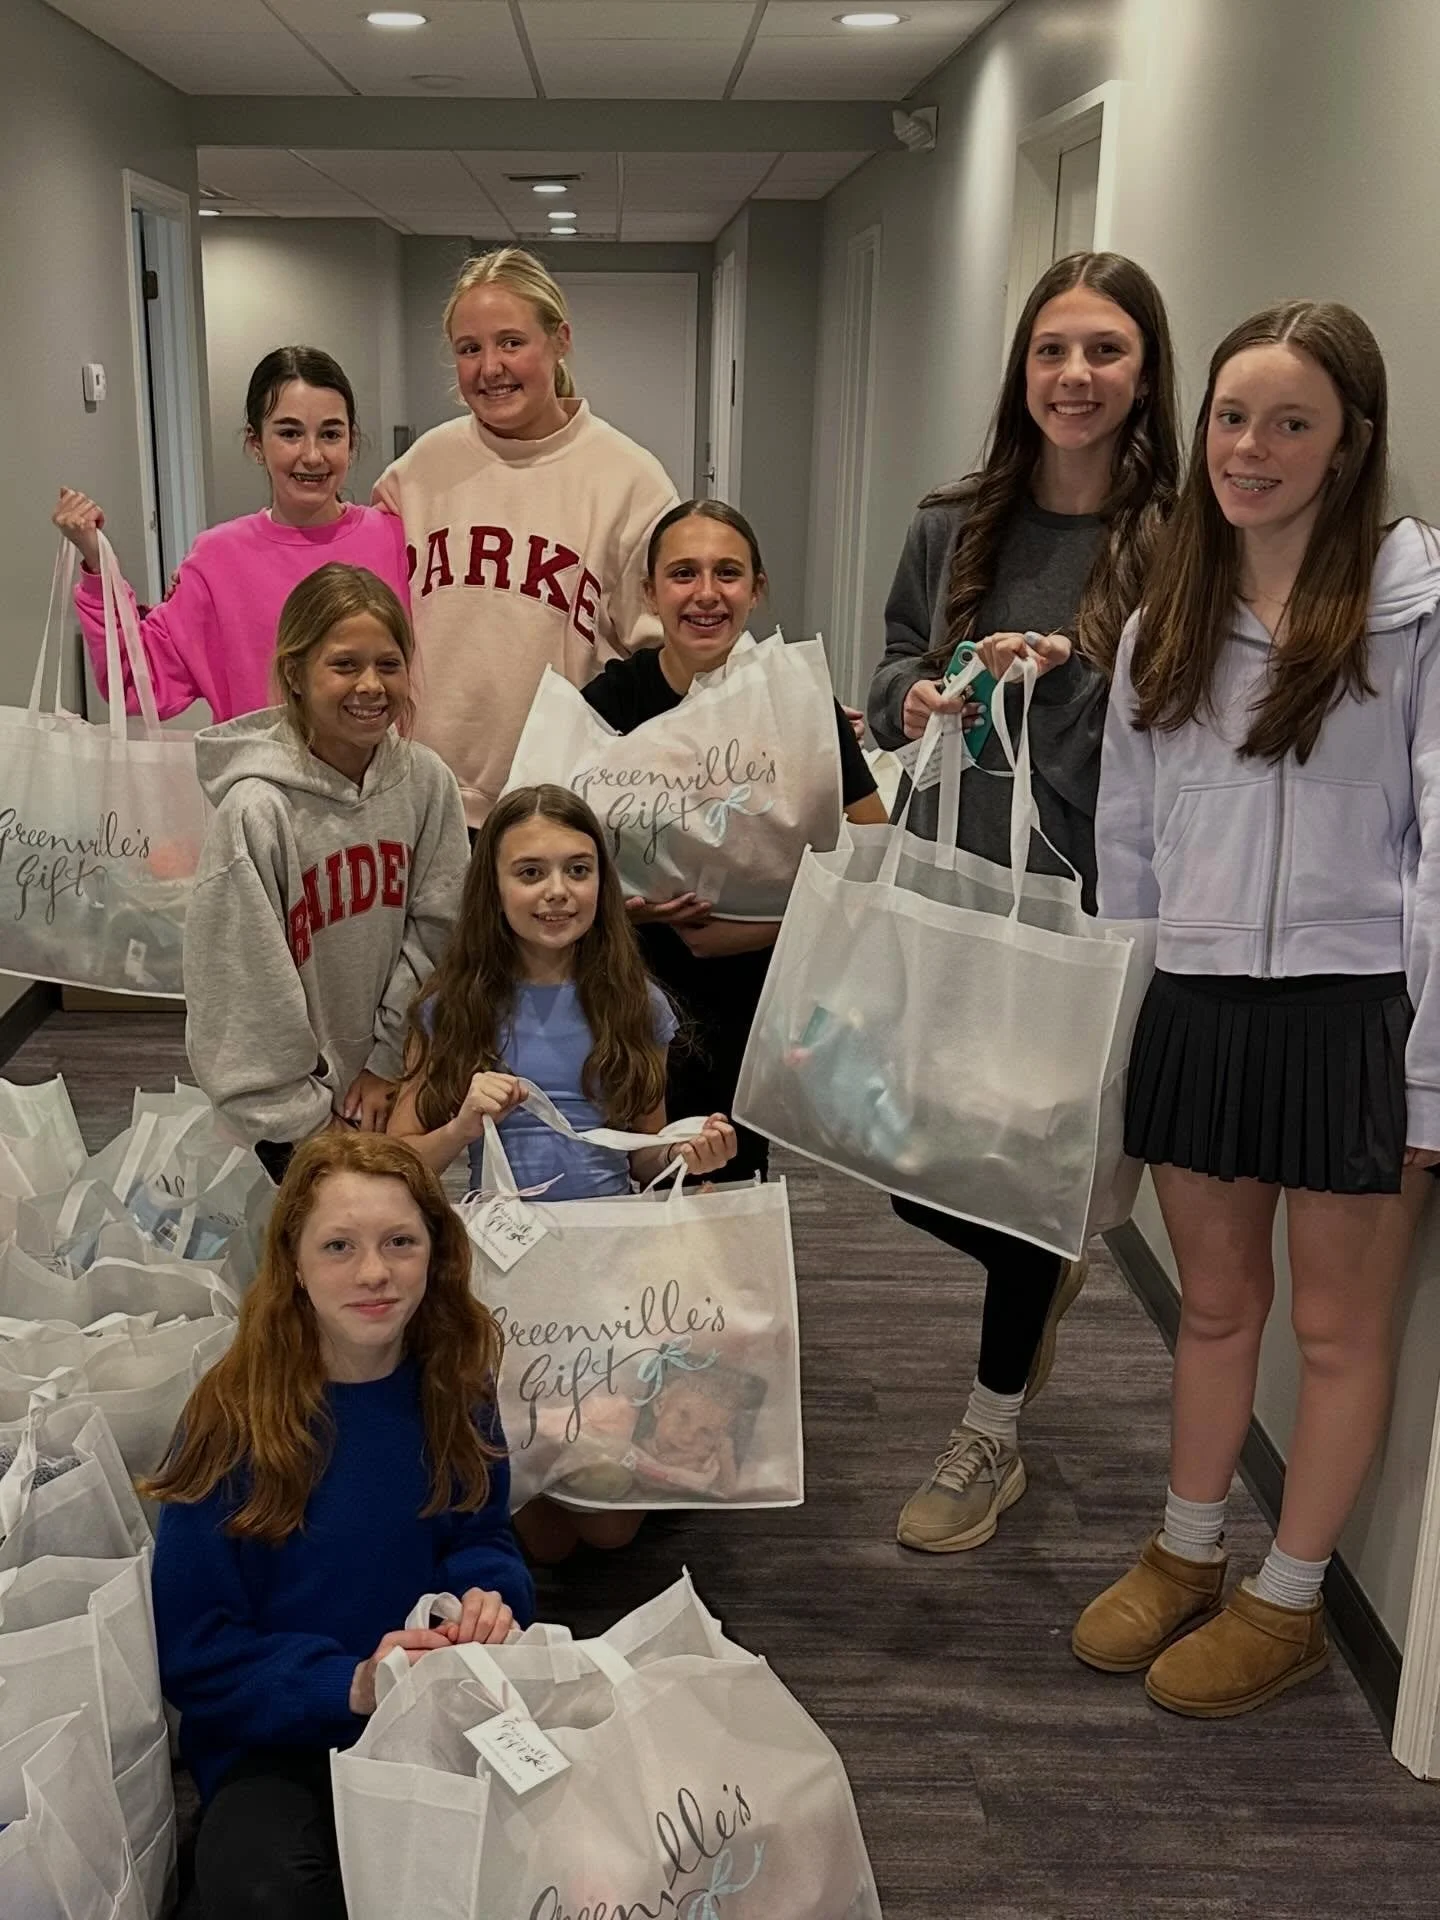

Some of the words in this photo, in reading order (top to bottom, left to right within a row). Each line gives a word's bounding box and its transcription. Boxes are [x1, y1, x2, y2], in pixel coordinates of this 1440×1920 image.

[606, 791, 712, 865] Gift
[14, 854, 106, 925] Gift
[288, 839, 413, 967] RAIDE
[519, 1346, 650, 1450] Gift
